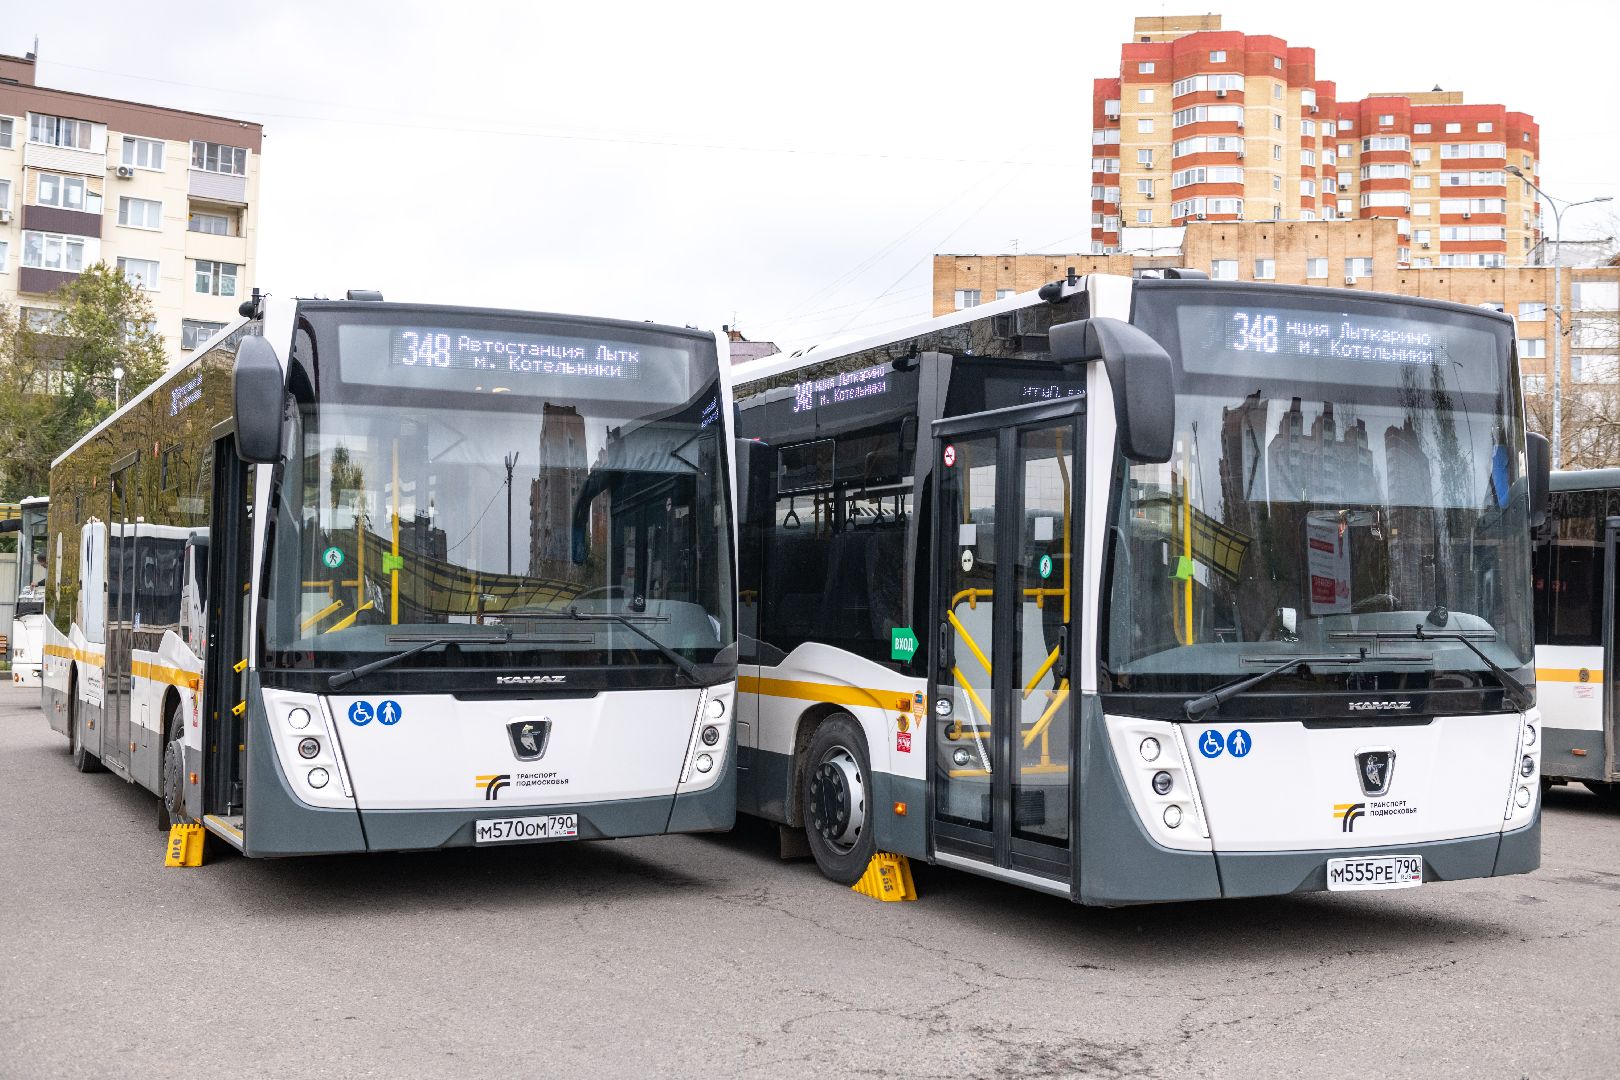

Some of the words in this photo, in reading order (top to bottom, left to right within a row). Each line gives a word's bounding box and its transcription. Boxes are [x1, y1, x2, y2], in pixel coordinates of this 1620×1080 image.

[1233, 312, 1278, 353] 348
[1286, 321, 1329, 337] нция
[1339, 322, 1431, 346] Лыткарино
[402, 331, 451, 368] 348
[458, 335, 584, 359] Автостанция
[596, 345, 640, 363] Лытк
[1331, 338, 1433, 363] Котельники
[509, 355, 622, 377] Котельники
[894, 637, 914, 652] ВХОД
[496, 675, 567, 684] KAMAZ
[1348, 701, 1412, 711] KAMAZ
[516, 778, 569, 787] ПОДМОСКОВЬЯ
[1370, 800, 1407, 808] ТРАНСПОРТ
[1370, 807, 1418, 817] ПОДМОСКОВЬЯ
[481, 821, 547, 839] М570ОМ
[549, 816, 573, 830] 790
[1333, 862, 1393, 883] М555РЕ
[1396, 858, 1417, 874] 790
